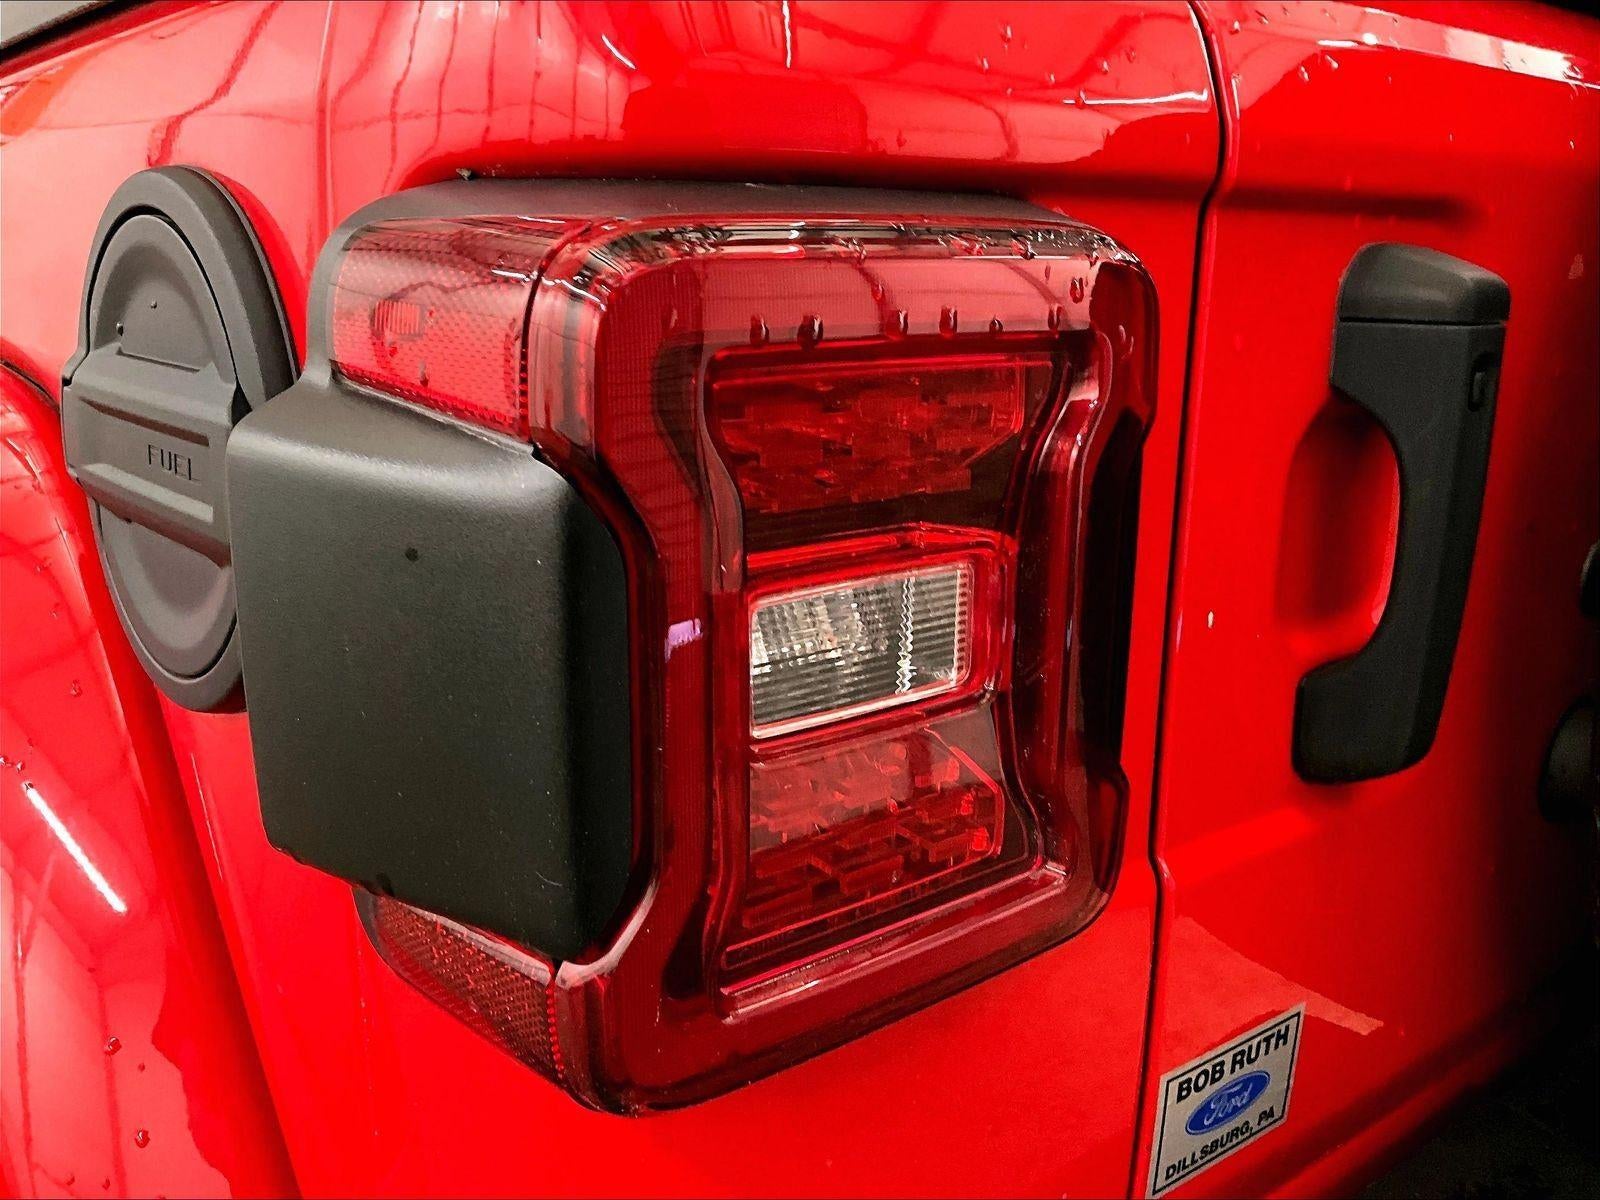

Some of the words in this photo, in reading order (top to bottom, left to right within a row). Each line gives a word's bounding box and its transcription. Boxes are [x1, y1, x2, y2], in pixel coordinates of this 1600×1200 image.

[147, 444, 200, 482] FUEL
[1176, 1061, 1225, 1104] BOB
[1230, 1024, 1290, 1074] RUTH
[1203, 1083, 1253, 1125] Ford
[1164, 1119, 1254, 1181] DILLSBURG,
[1257, 1105, 1275, 1126] PA
